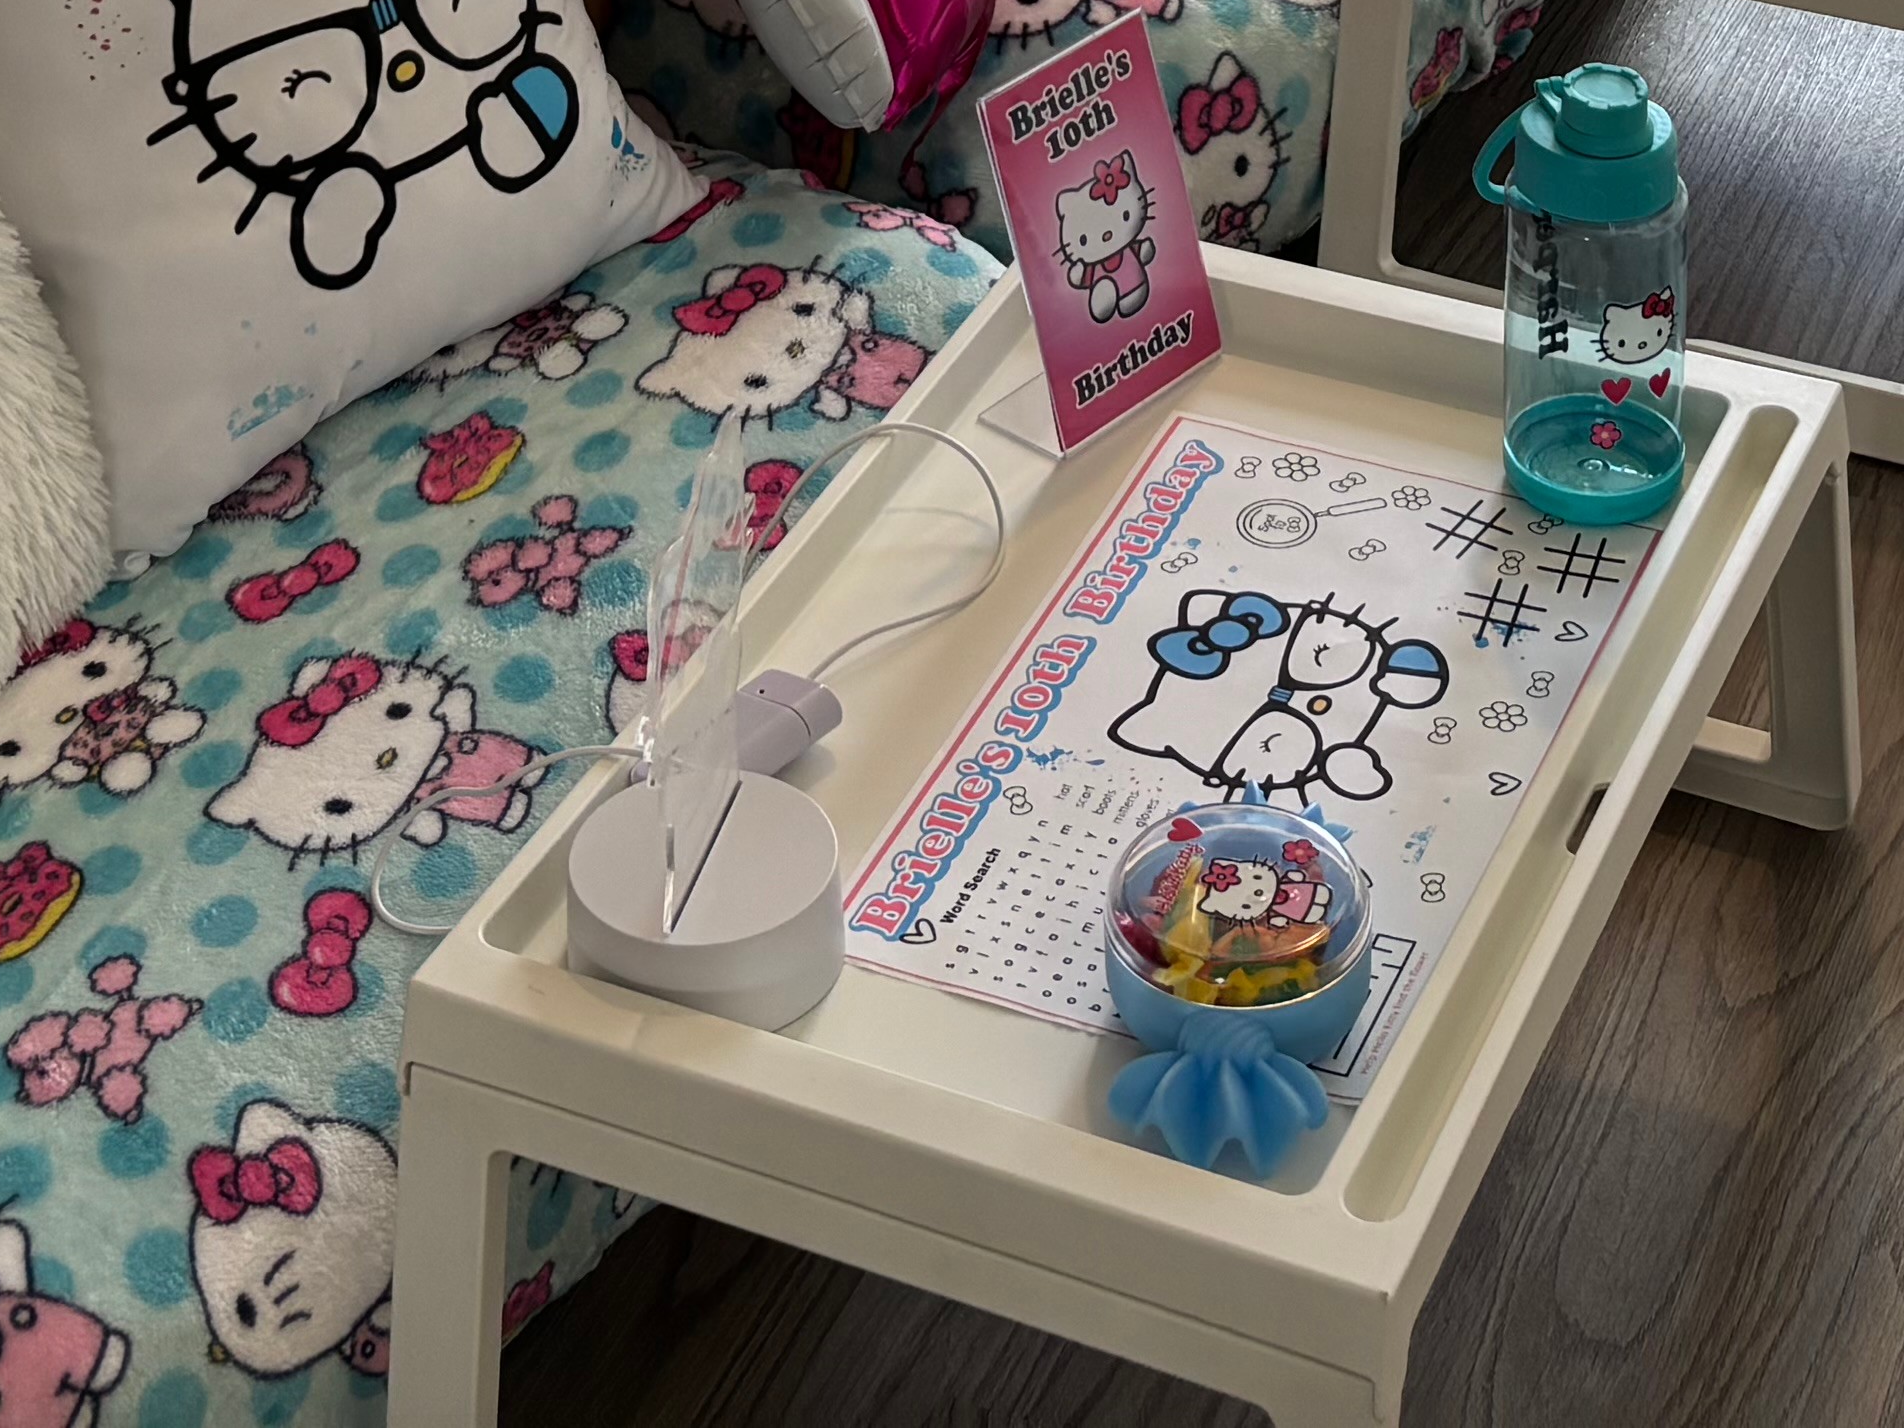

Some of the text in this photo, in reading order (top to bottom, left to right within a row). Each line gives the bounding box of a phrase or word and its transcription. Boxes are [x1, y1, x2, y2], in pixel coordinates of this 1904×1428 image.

[1007, 49, 1132, 144] Brielle's
[1045, 97, 1117, 162] 10th
[1072, 309, 1194, 409] Birthday
[849, 439, 1224, 942] Brielle's 10th Birthday
[939, 846, 1002, 925] Word Search
